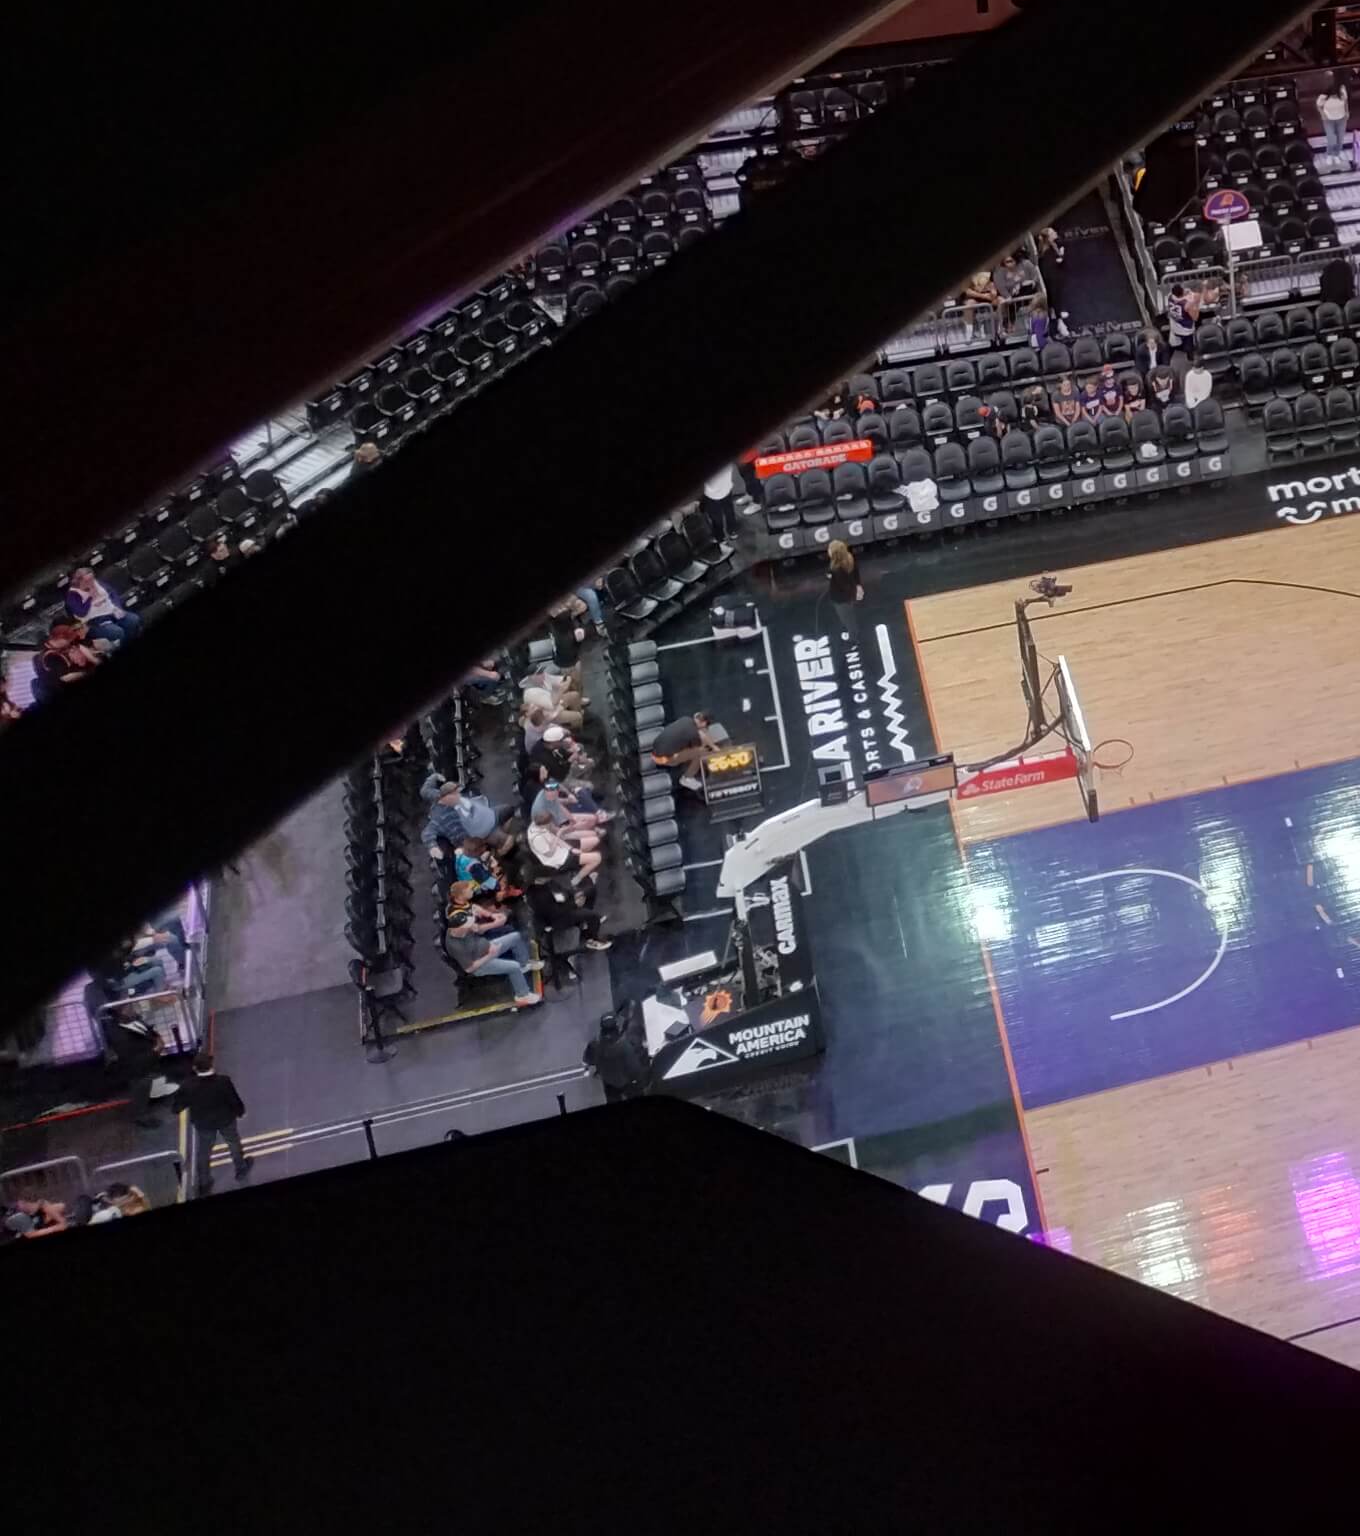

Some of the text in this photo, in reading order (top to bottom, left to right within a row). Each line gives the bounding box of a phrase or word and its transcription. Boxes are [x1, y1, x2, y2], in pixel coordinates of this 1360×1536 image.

[794, 635, 848, 736] RIVER
[729, 1014, 810, 1044] MOUNTAIN
[736, 1028, 807, 1055] AMERICA
